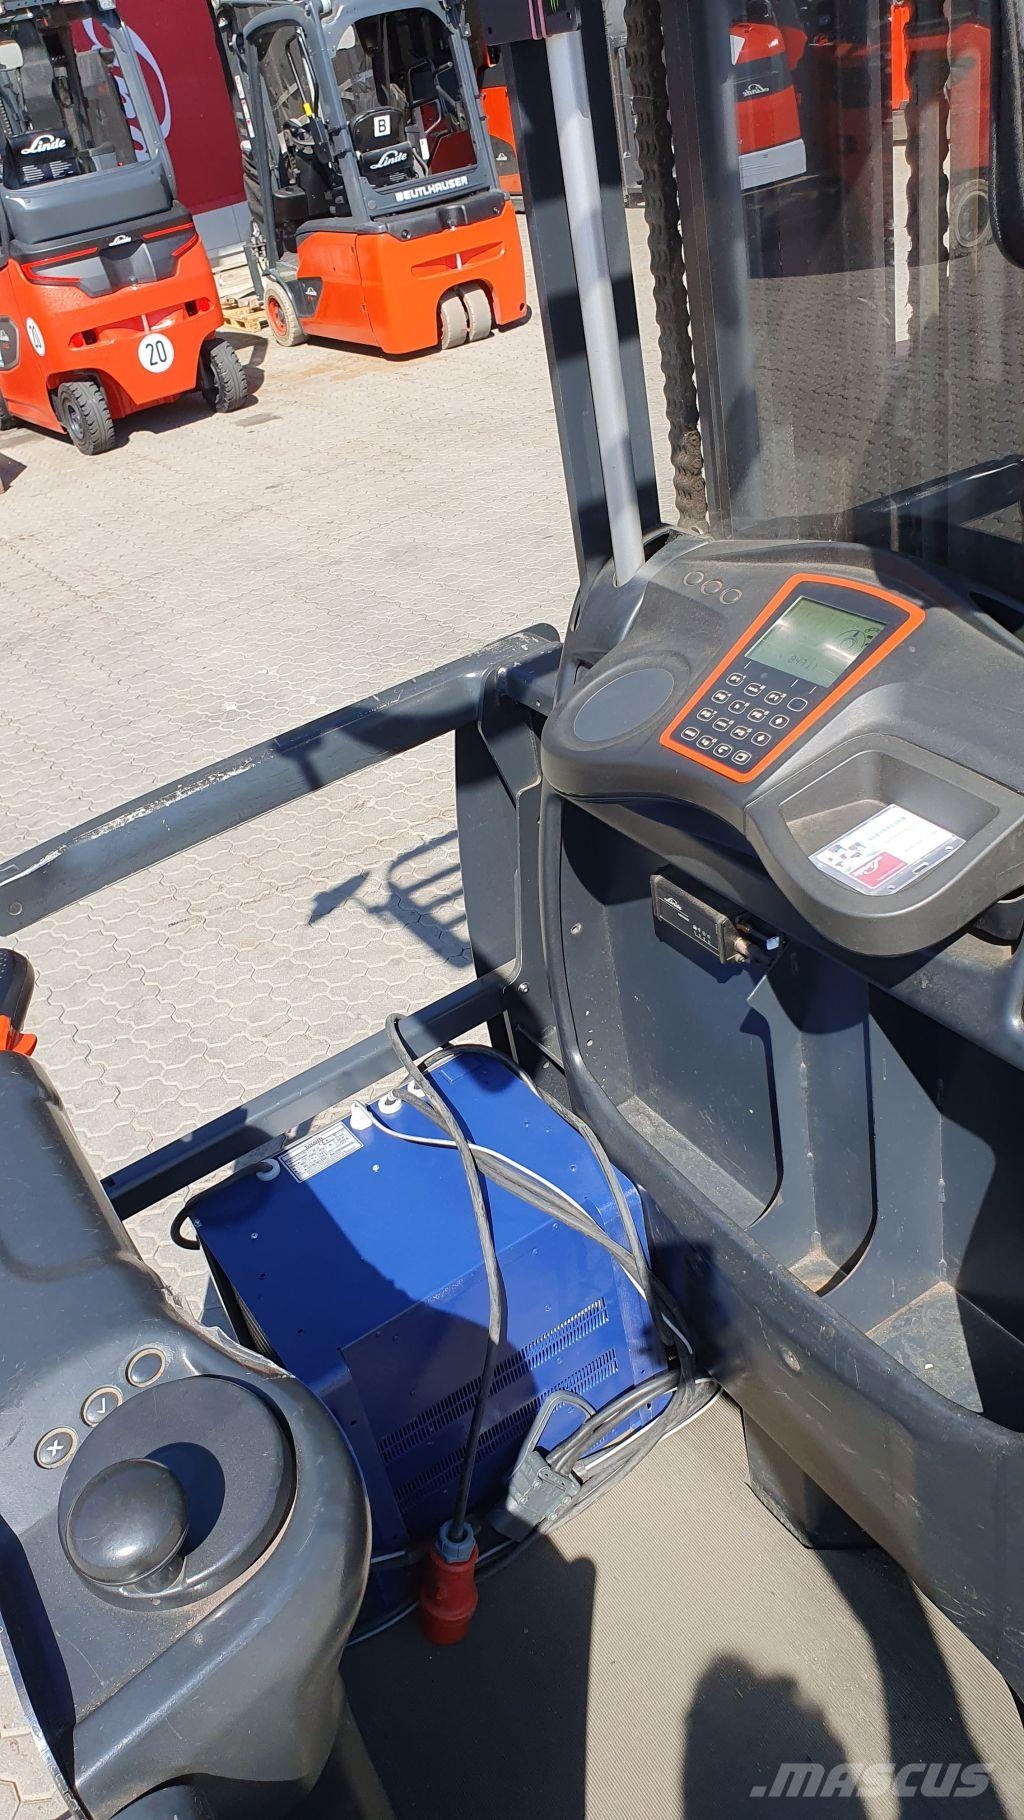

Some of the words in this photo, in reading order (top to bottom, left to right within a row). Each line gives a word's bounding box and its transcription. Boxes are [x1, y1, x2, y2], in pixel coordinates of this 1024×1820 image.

[378, 119, 387, 133] B
[21, 134, 67, 155] Linde
[370, 150, 408, 170] Linde
[395, 175, 469, 203] BEUTLHAUSER
[145, 340, 168, 367] 20
